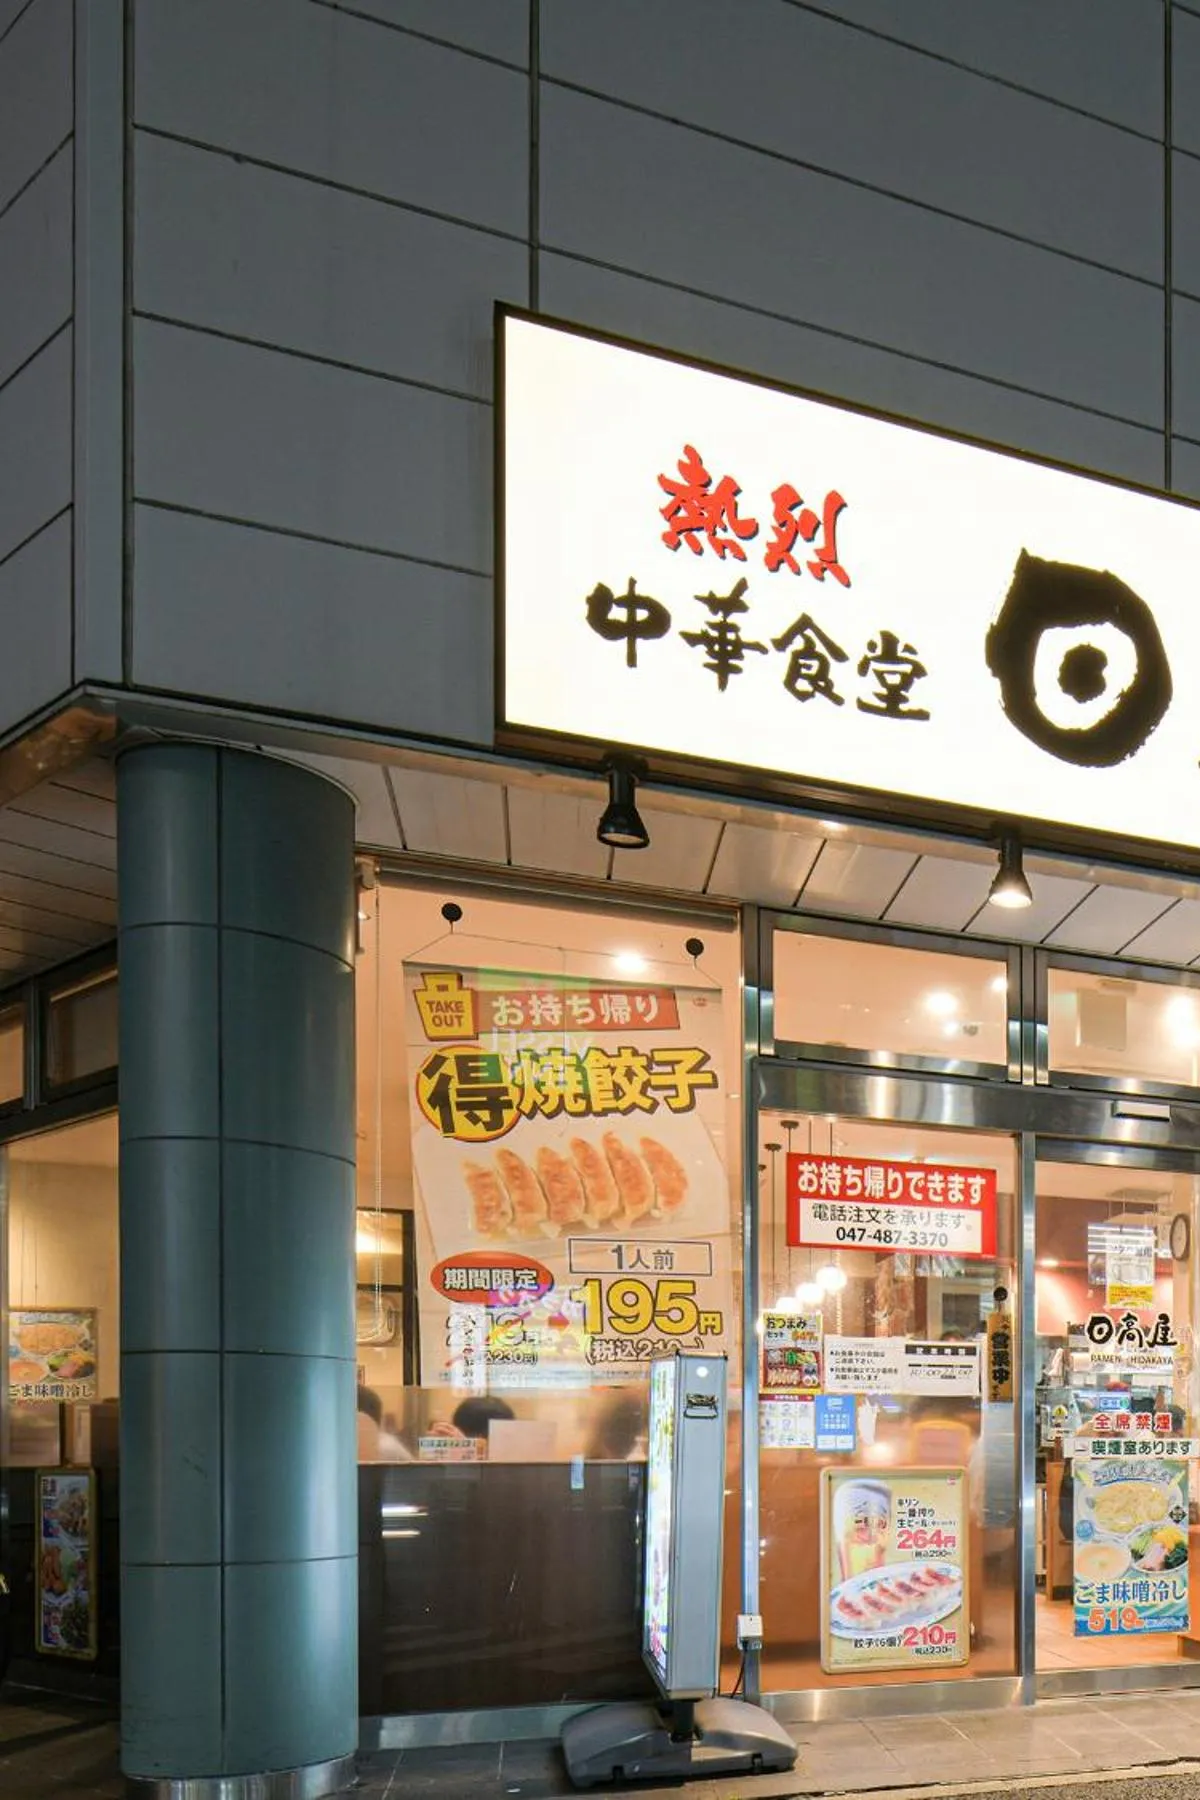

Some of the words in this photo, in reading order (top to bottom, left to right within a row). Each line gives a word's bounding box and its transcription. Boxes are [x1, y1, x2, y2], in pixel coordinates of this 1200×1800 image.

[657, 444, 851, 588] 熱烈
[585, 576, 931, 722] 中華食堂
[425, 1000, 464, 1015] TAKE
[491, 990, 660, 1027] お持ち帰り
[431, 1013, 463, 1029] OUT
[797, 1161, 987, 1205] お持ち帰りできます
[836, 1226, 949, 1247] 047-487-3370
[610, 1243, 675, 1271] 1人前
[442, 1266, 538, 1292] 期間限定
[571, 1278, 722, 1336] 195円
[1087, 1312, 1177, 1348] 日高屋
[1091, 1353, 1122, 1364] RAMEN
[1094, 1413, 1171, 1431] 全席禁煙
[1091, 1439, 1192, 1456] 喫煙室あります
[896, 1528, 957, 1550] 264円
[1075, 1579, 1187, 1605] ごま味噌冷し
[902, 1625, 957, 1647] 210円
